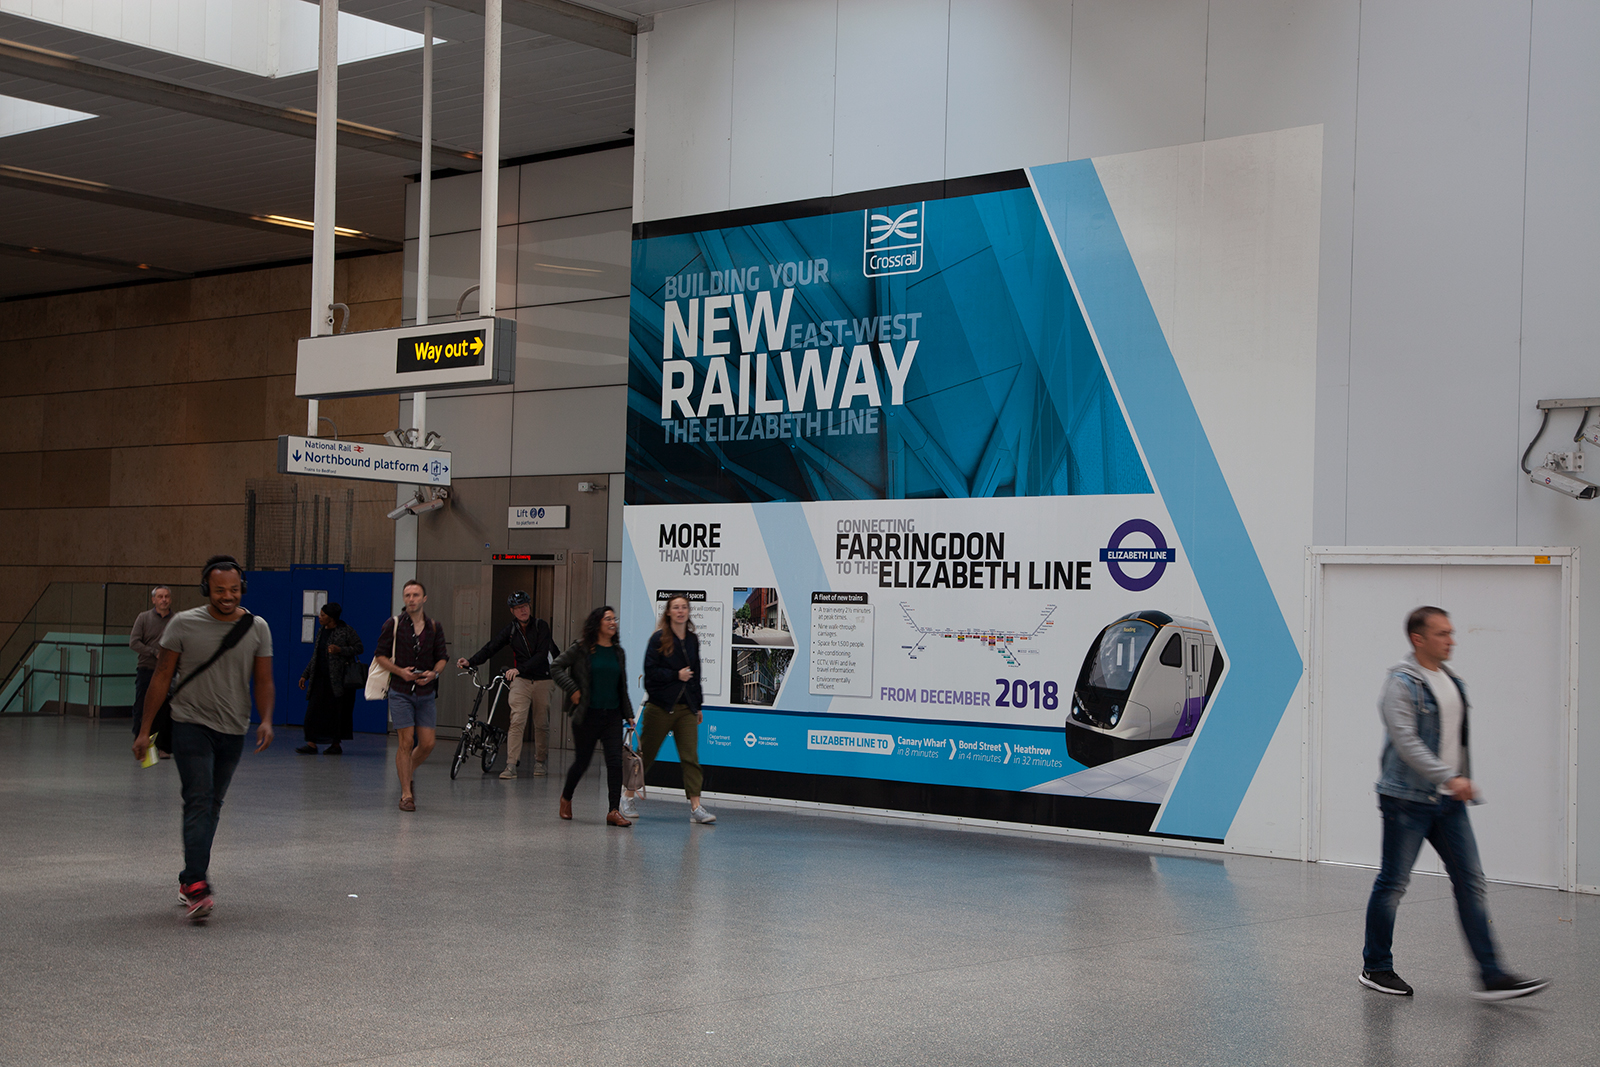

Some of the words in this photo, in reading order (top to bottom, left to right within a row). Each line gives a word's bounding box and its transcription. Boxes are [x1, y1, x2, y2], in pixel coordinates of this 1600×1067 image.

[870, 250, 917, 269] Crossrail
[664, 266, 760, 299] BUILDING
[768, 258, 830, 289] YOUR
[663, 288, 795, 359] NEW
[790, 312, 923, 349] EAST-WEST
[414, 341, 443, 364] Way
[444, 339, 469, 359] out
[661, 340, 920, 419] RAILWAY
[661, 419, 700, 444] THE
[705, 411, 822, 442] ELIZABETH
[827, 408, 879, 436] LINE
[304, 440, 337, 451] National
[338, 444, 351, 453] Rail
[304, 451, 371, 468] Northbound
[373, 458, 420, 473] platform
[422, 463, 429, 473] 4
[516, 509, 528, 518] Lift
[836, 519, 915, 533] CONNECTING
[659, 523, 721, 548] MORE
[836, 532, 1005, 560] FARRINGDON
[659, 549, 689, 562] THAN
[690, 549, 716, 565] JUST
[1107, 551, 1148, 560] ELIZABETH
[1149, 551, 1167, 560] LINE
[683, 563, 691, 576] A
[693, 563, 739, 576] STATION
[836, 561, 851, 575] TO
[854, 561, 879, 575] THE
[879, 561, 1020, 589] ELIZABETH
[1028, 561, 1092, 590] LINE
[880, 686, 916, 703] FROM
[920, 689, 991, 707] DECEMBER
[995, 678, 1059, 711] 2018
[810, 734, 855, 747] ELIZABETH
[856, 738, 876, 748] LINE
[877, 739, 889, 749] TO
[897, 736, 922, 748] Canary
[923, 738, 947, 748] Wharf
[959, 740, 978, 750] Bond
[979, 742, 1002, 752] Street
[897, 747, 904, 755] in
[904, 747, 910, 756] 8
[911, 748, 939, 759] minutes
[958, 751, 966, 759] in
[966, 752, 972, 760] 4
[972, 752, 1002, 764] minutes
[1014, 744, 1052, 756] Heathrow
[1013, 755, 1021, 764] in
[1021, 755, 1031, 766] 32
[1032, 757, 1063, 768] minutes
